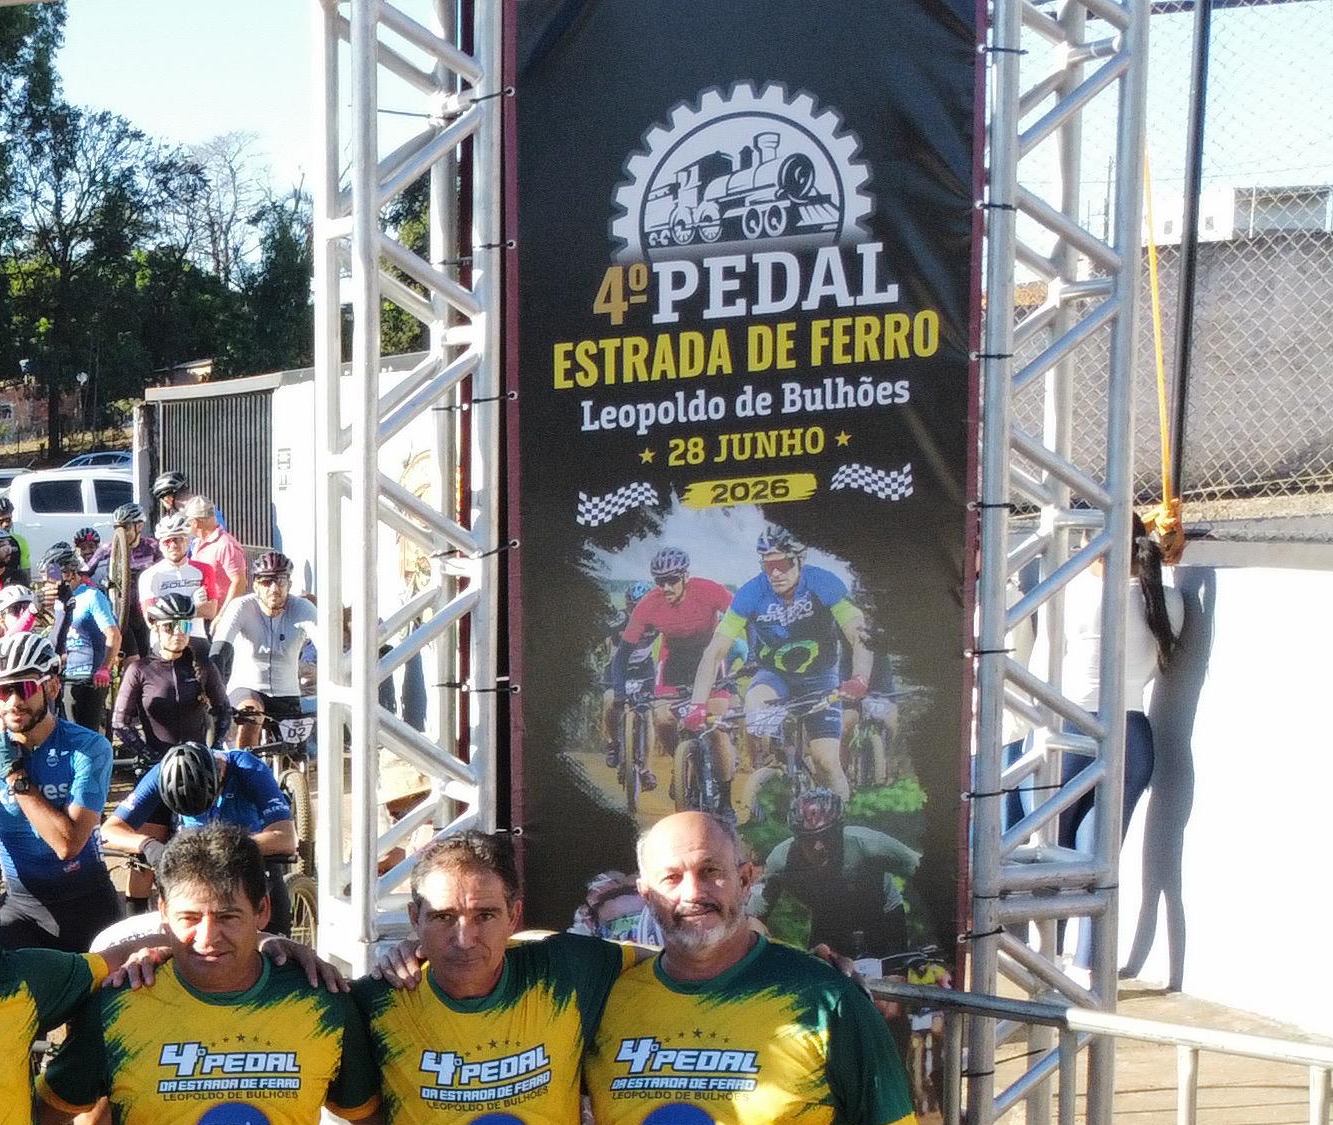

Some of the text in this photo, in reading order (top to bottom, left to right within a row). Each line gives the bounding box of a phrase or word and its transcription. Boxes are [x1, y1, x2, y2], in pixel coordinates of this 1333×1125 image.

[593, 242, 899, 325] 4º PEDAL
[553, 309, 940, 390] ESTRADA DE FERRO
[581, 375, 911, 435] Leopoldo de Bulhões
[668, 426, 826, 467] 28 JUNHO
[711, 478, 791, 504] 2026
[201, 1053, 300, 1074] PEDAL
[461, 1045, 550, 1084] PEDAL
[652, 1050, 761, 1072] PEDAL
[163, 1090, 224, 1101] LEOPOLDO
[178, 1080, 238, 1090] ESTRADA
[240, 1079, 257, 1088] DE
[259, 1078, 299, 1088] FERRO
[440, 1088, 496, 1101] ESTRADA
[497, 1085, 512, 1096] DE
[515, 1070, 550, 1093] FERRO
[613, 1091, 671, 1099] LEOPOLDO
[627, 1078, 687, 1088] ESTRADA
[689, 1078, 706, 1089] DE
[708, 1079, 756, 1090] FERRO
[427, 1101, 483, 1112] LEOPOLDO
